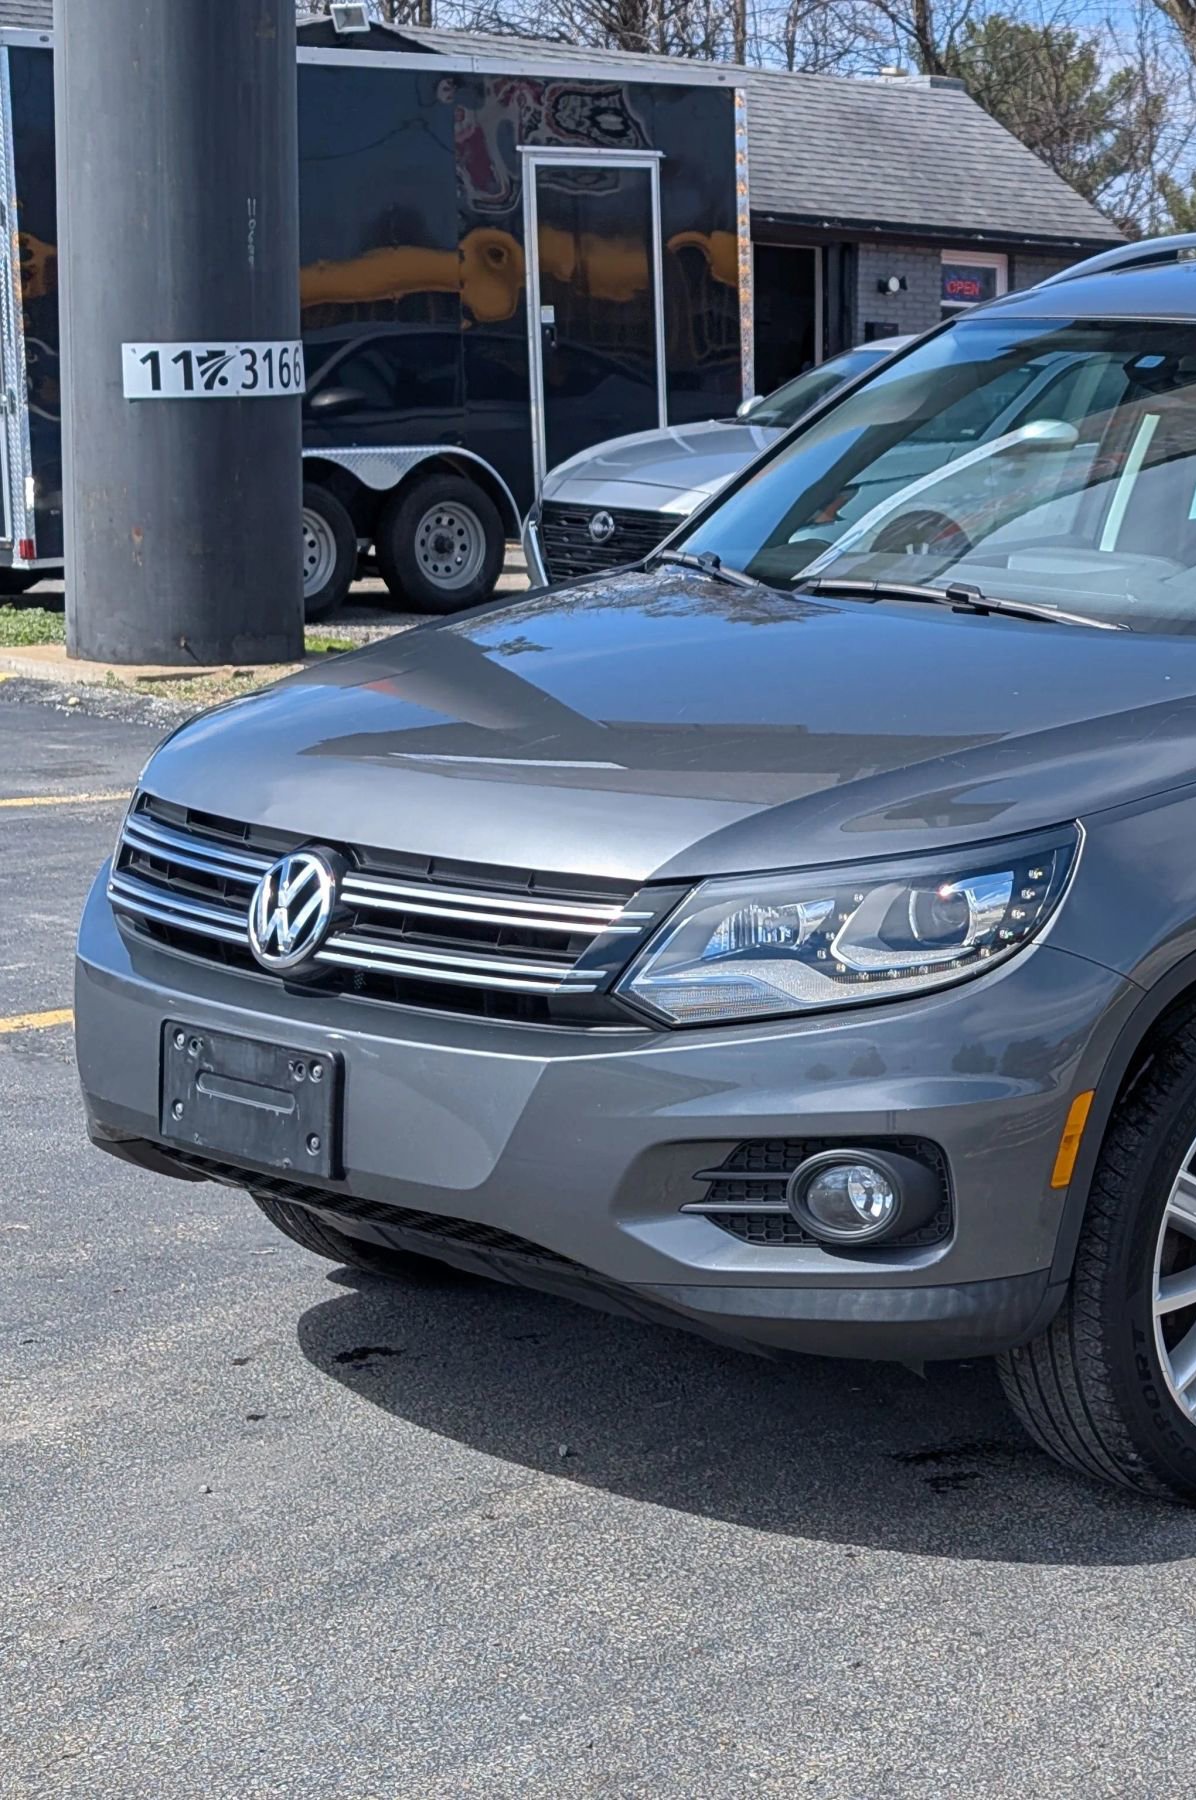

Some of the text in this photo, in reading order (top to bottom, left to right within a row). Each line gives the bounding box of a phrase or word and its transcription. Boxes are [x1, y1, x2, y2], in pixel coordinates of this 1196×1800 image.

[946, 280, 980, 297] OPEN
[139, 346, 302, 391] 11 3166
